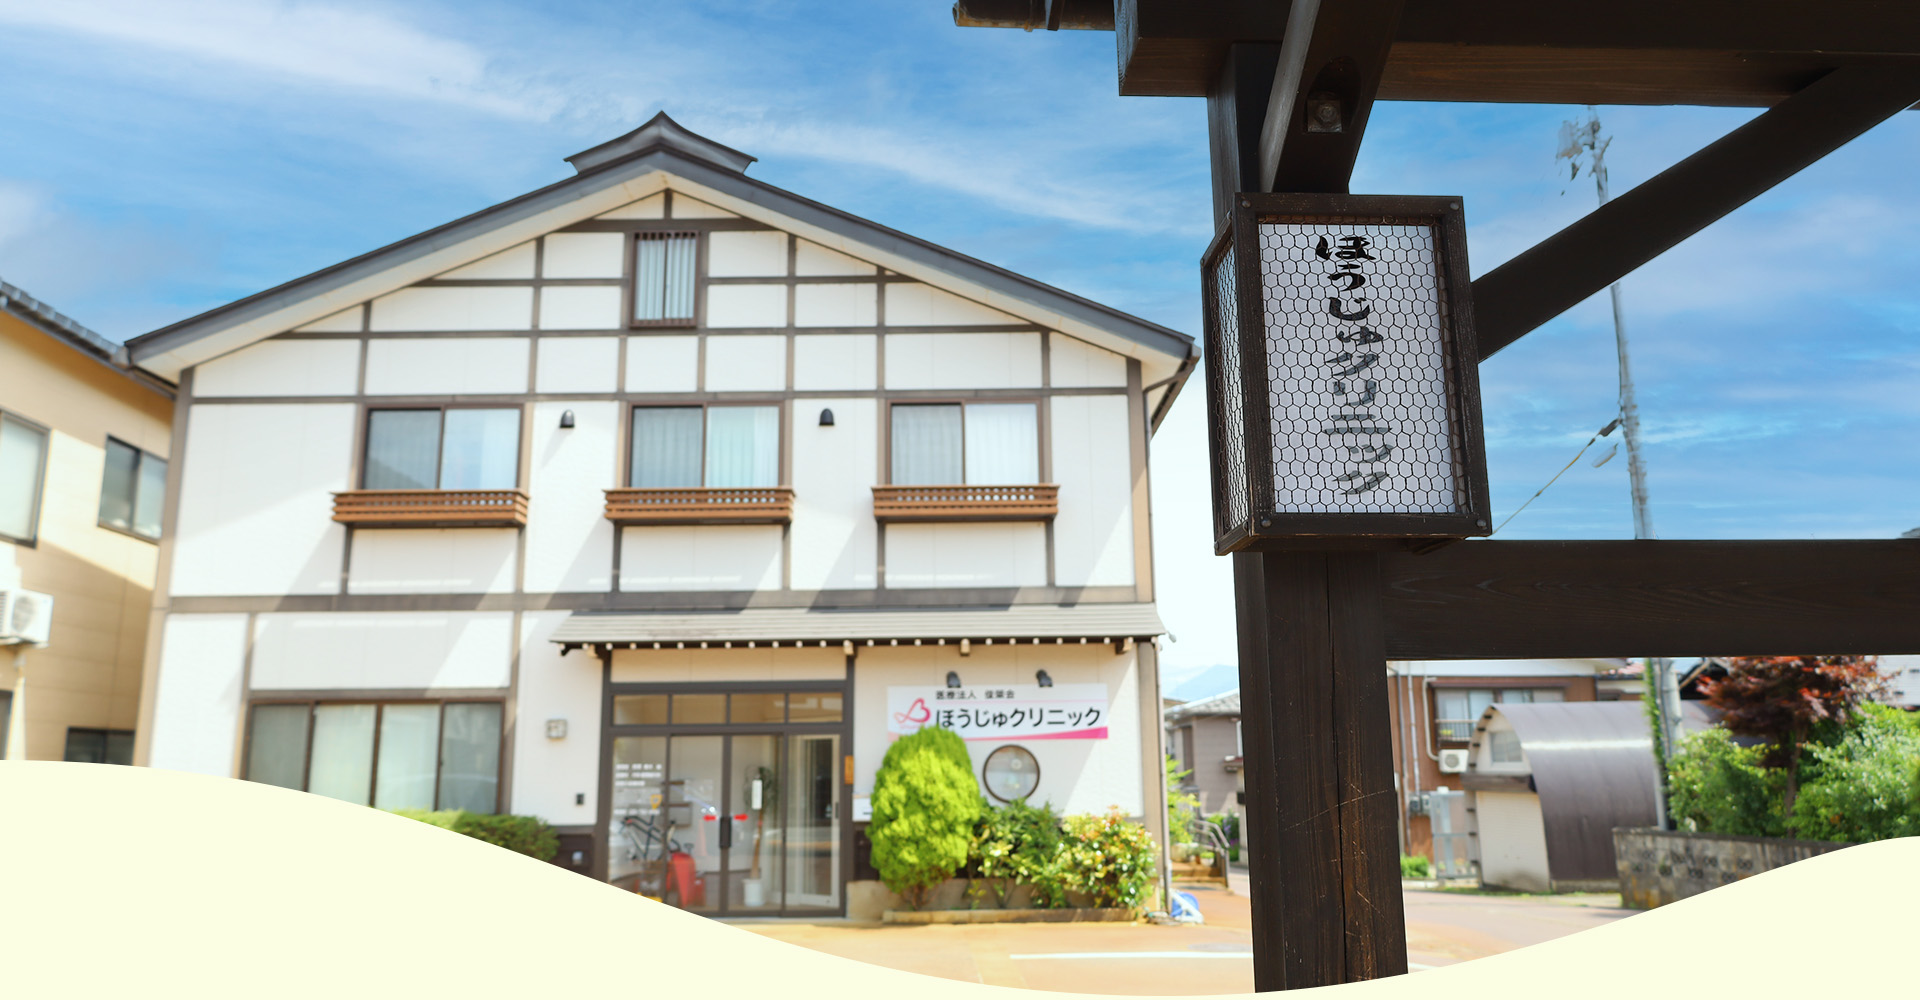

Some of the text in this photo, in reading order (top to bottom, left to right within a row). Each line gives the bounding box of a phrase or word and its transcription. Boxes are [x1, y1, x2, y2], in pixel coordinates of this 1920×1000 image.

[1315, 235, 1394, 495] ほうじゅクリニック
[936, 689, 977, 700] 医療法人
[936, 707, 1101, 729] ほうじゅクリニック
